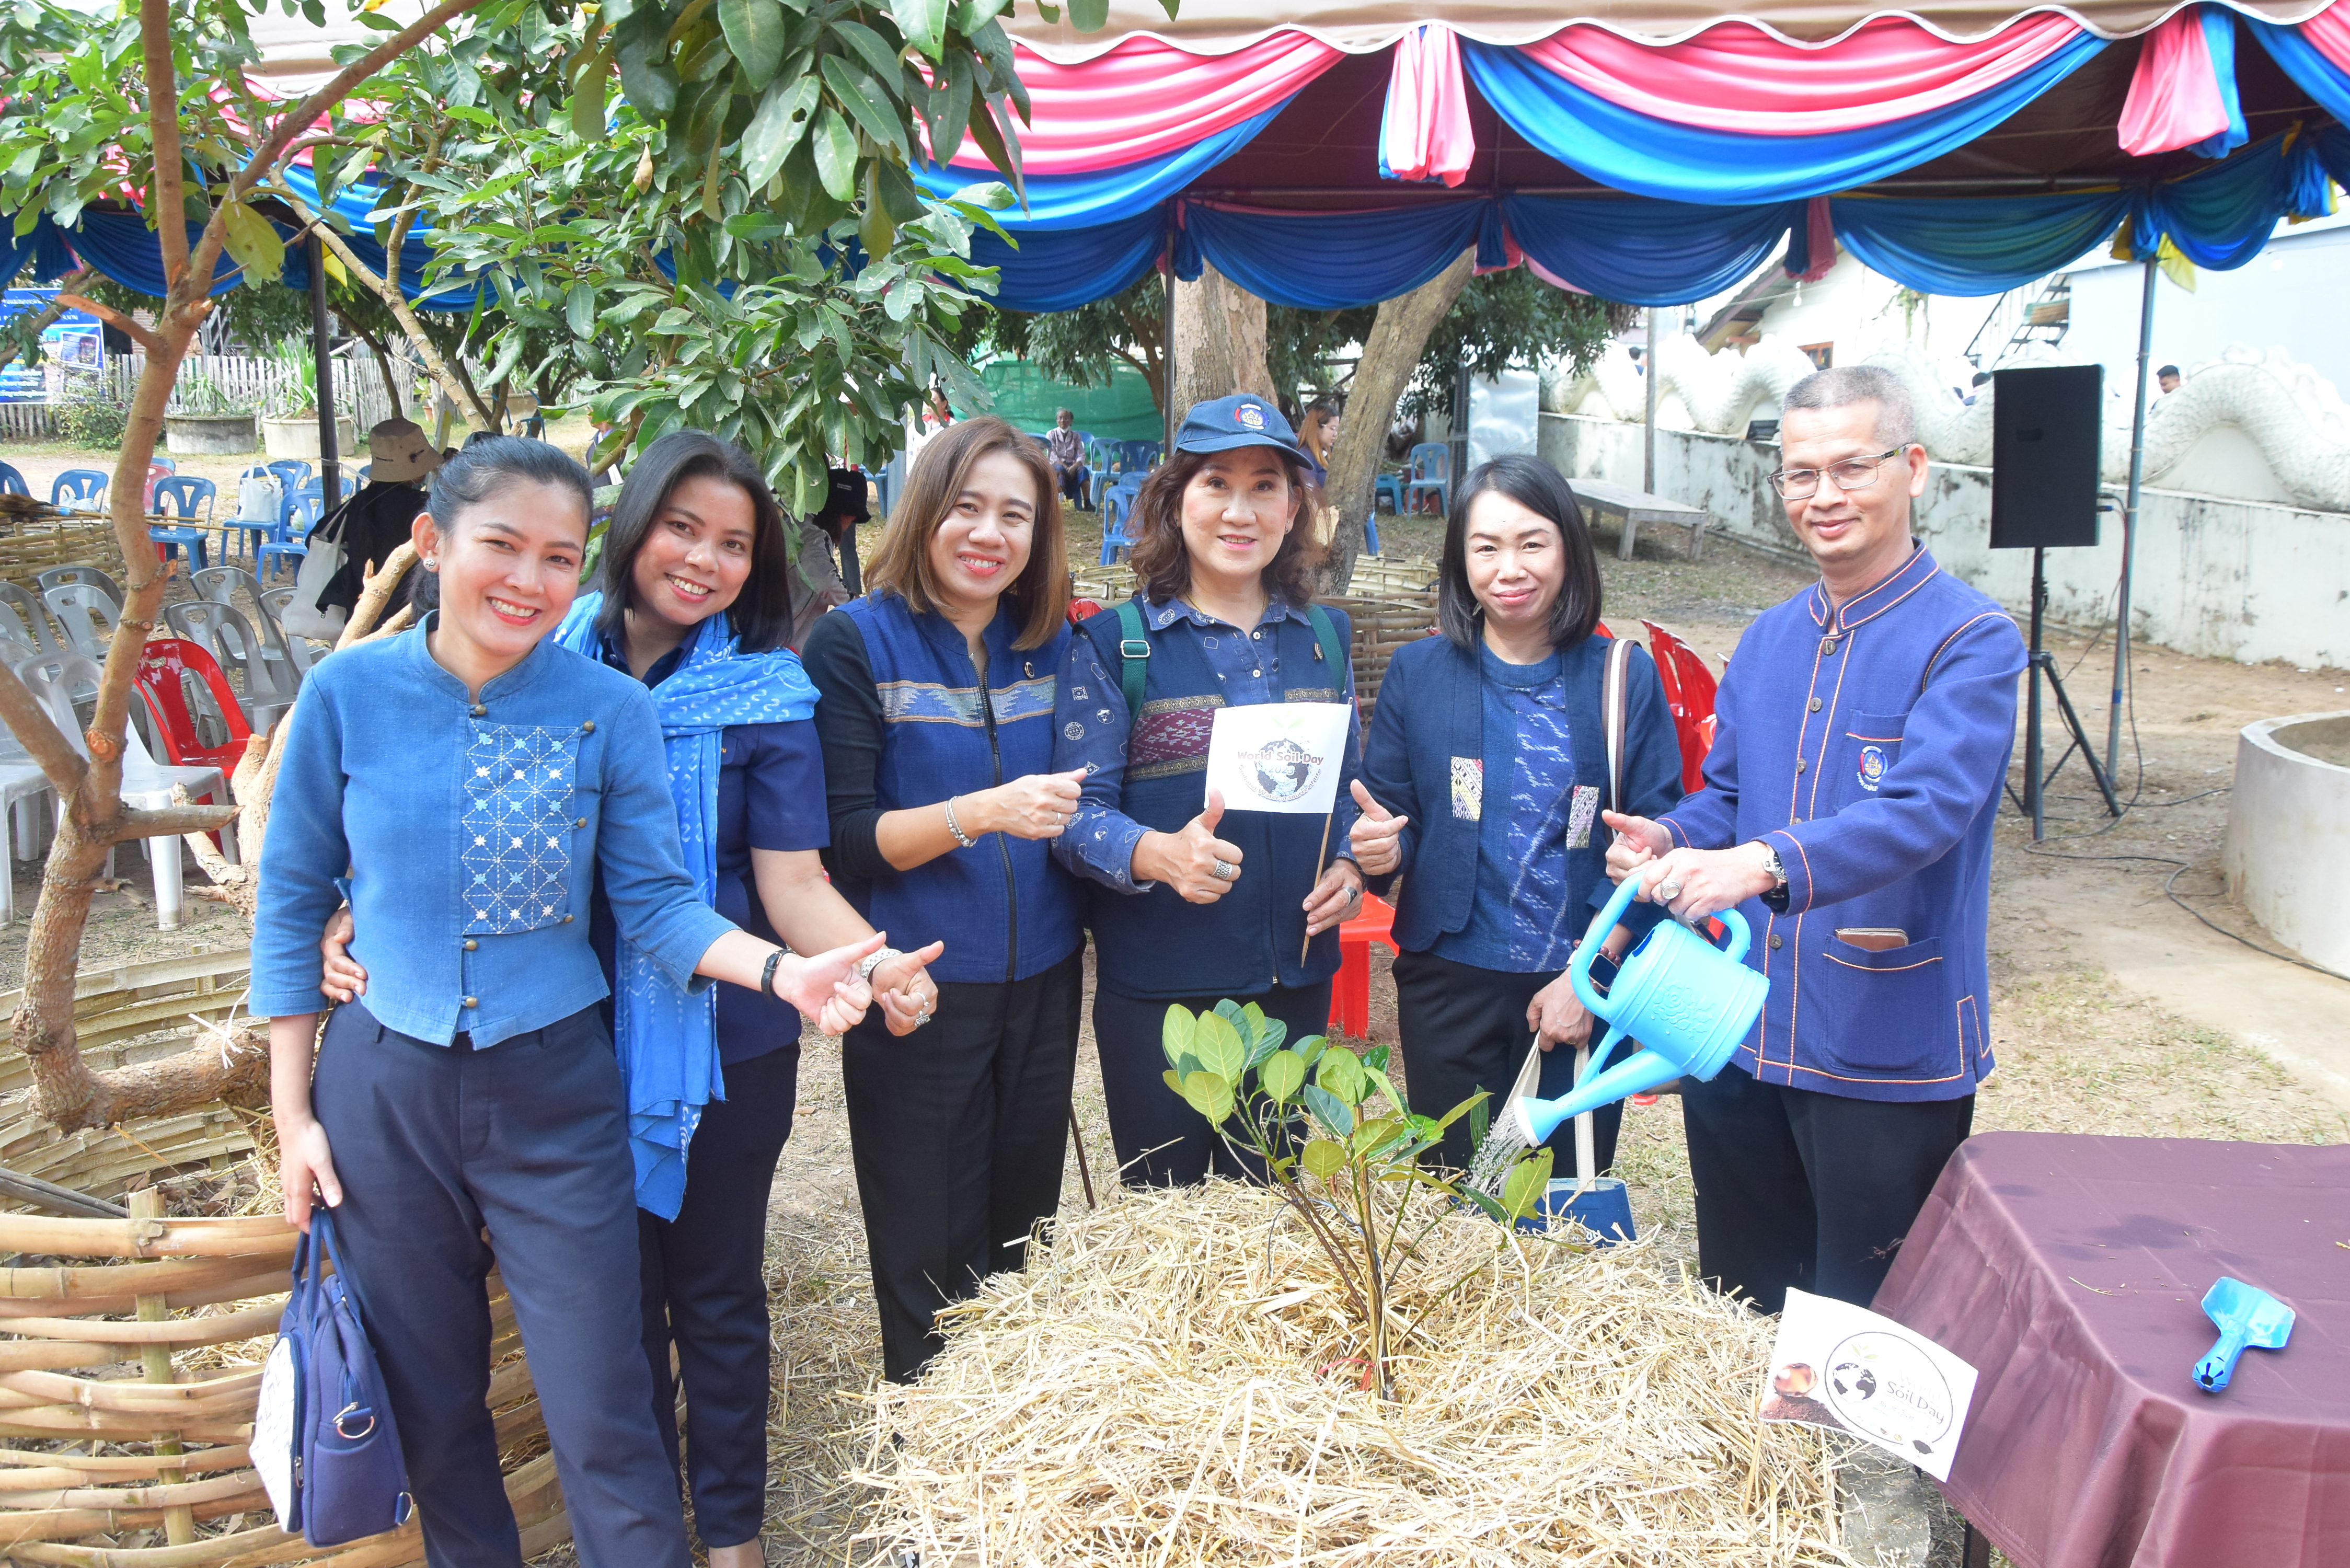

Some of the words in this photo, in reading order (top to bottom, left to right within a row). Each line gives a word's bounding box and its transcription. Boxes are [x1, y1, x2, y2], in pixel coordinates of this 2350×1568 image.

[1237, 751, 1272, 760] World
[1276, 752, 1299, 762] Soil
[1303, 753, 1324, 766] Day
[1269, 766, 1294, 775] 2023
[1246, 779, 1258, 791] and
[1258, 788, 1281, 801] Water:
[1288, 788, 1308, 801] source
[1900, 1369, 1941, 1403] World
[1886, 1381, 1914, 1404] Soil
[1917, 1396, 1944, 1424] Day
